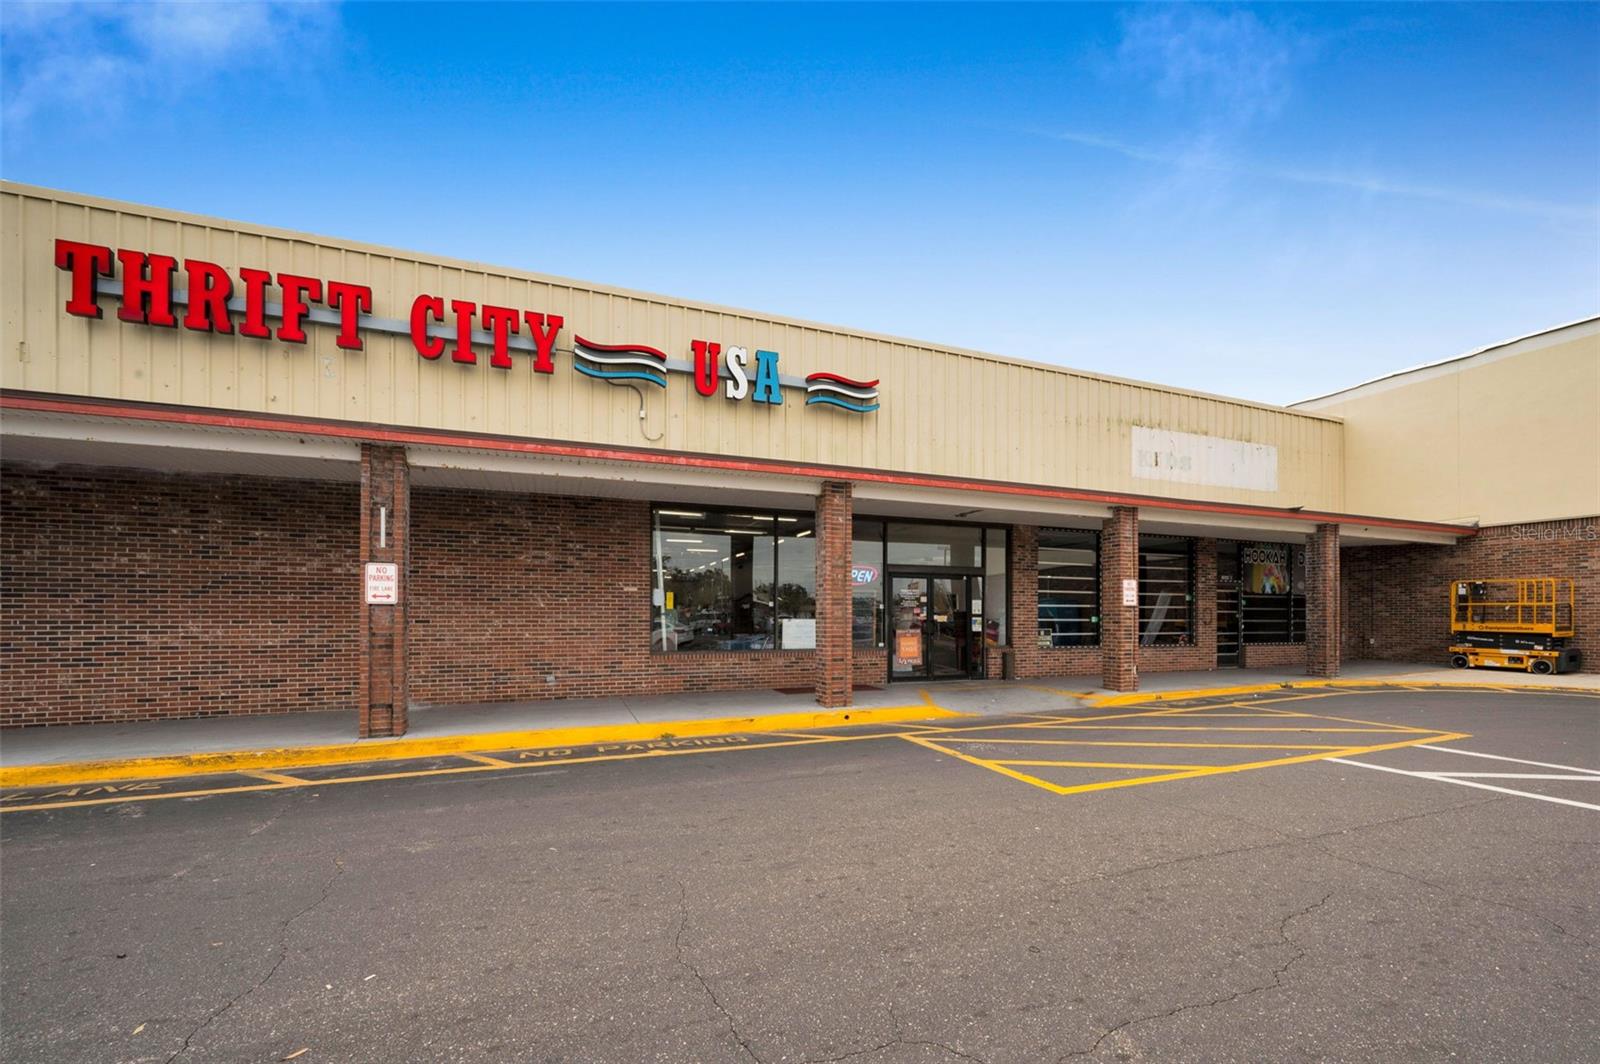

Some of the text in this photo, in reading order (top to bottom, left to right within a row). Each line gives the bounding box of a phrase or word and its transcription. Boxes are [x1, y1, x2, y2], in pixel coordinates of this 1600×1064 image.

[55, 239, 783, 405] THRIFT CITY USA
[1243, 547, 1286, 566] HOOKAH
[369, 574, 394, 582] PARKING
[376, 566, 388, 575] NO
[851, 569, 874, 583] PEN
[519, 736, 749, 759] NO PARKING
